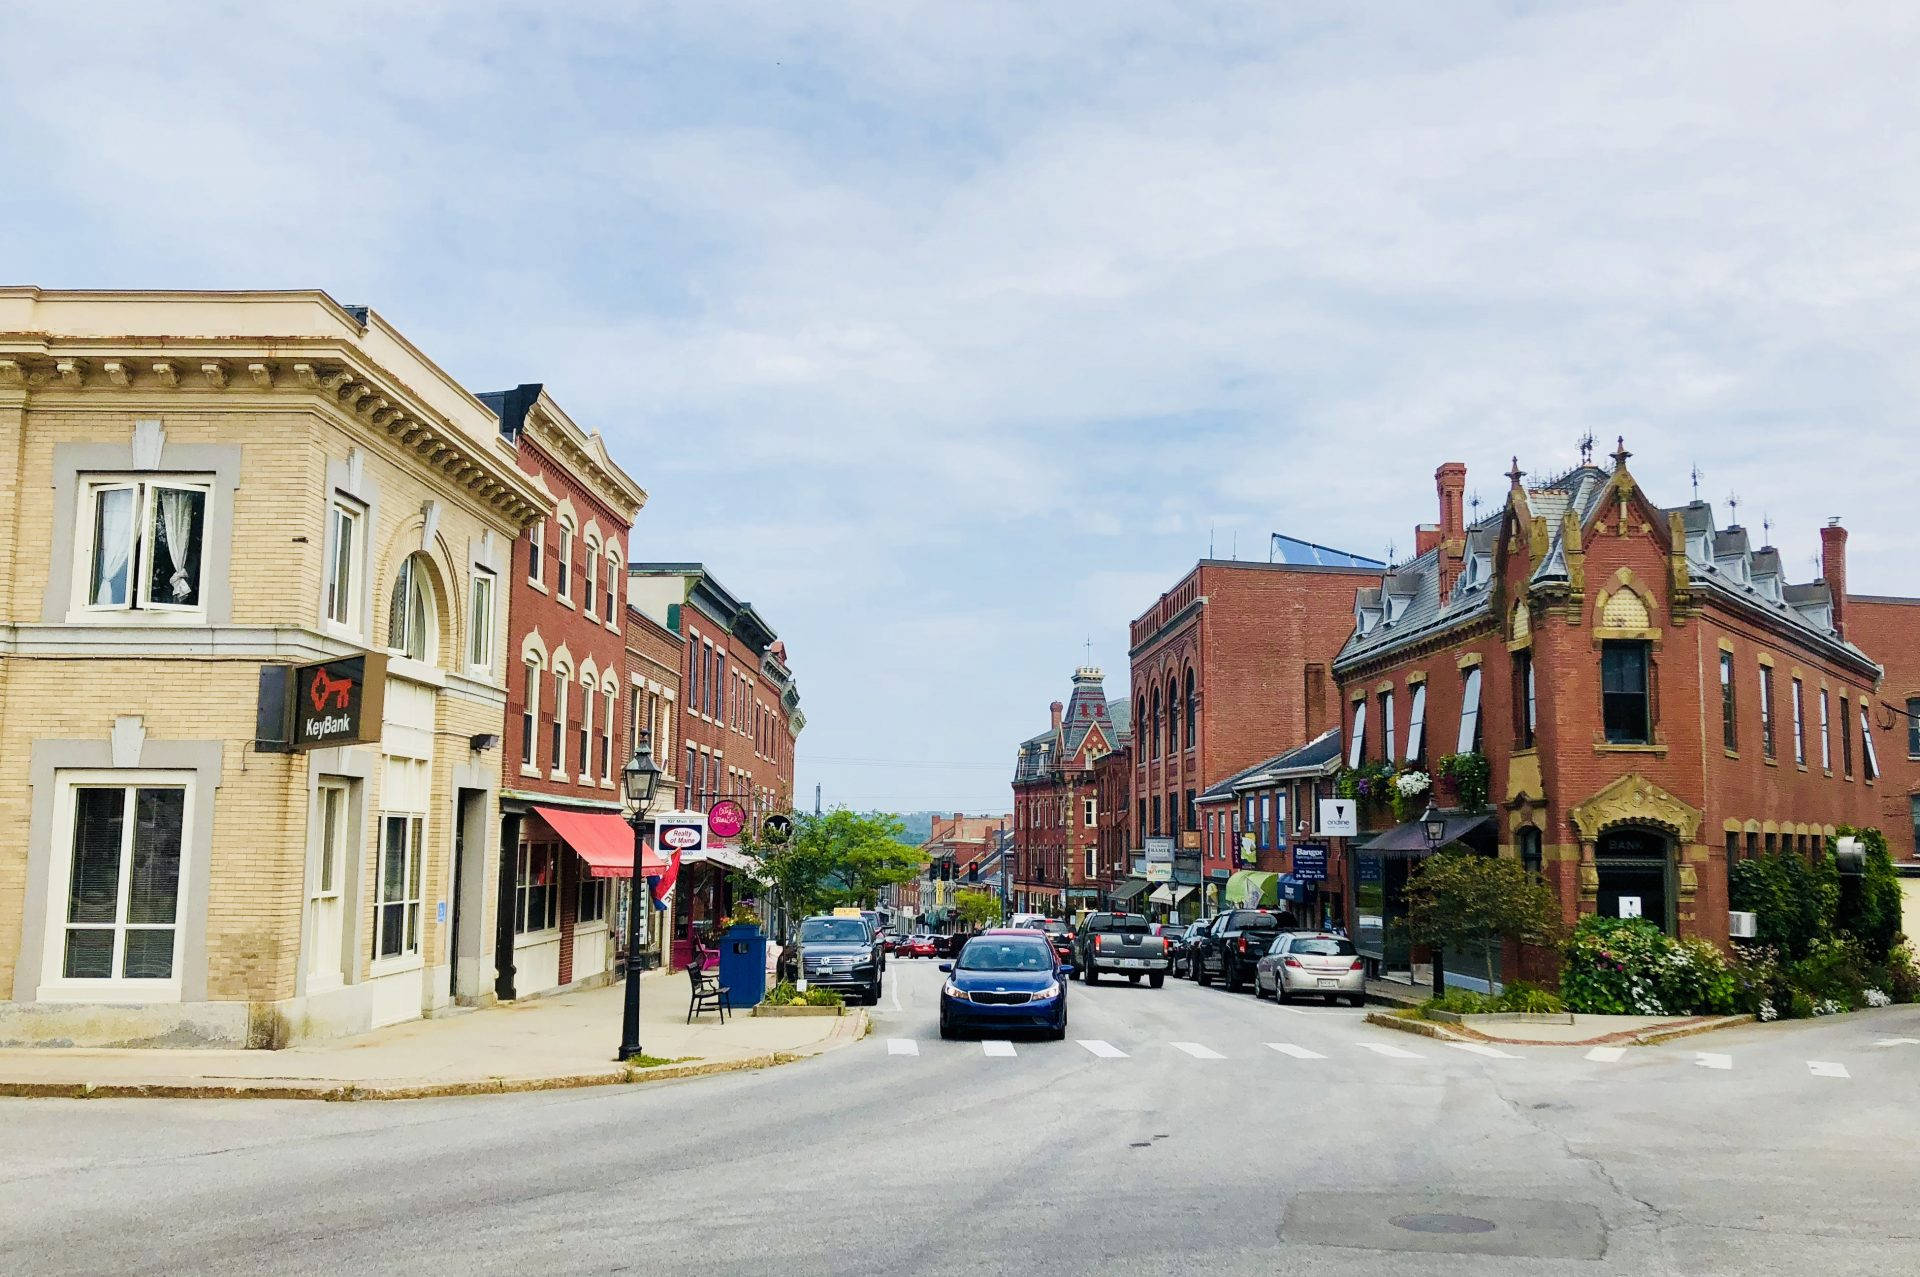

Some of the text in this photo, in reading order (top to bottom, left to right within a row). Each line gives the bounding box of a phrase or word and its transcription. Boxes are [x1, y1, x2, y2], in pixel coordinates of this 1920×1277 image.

[306, 713, 350, 740] KeyBank
[673, 829, 693, 838] Realty
[1296, 847, 1324, 857] Bangor
